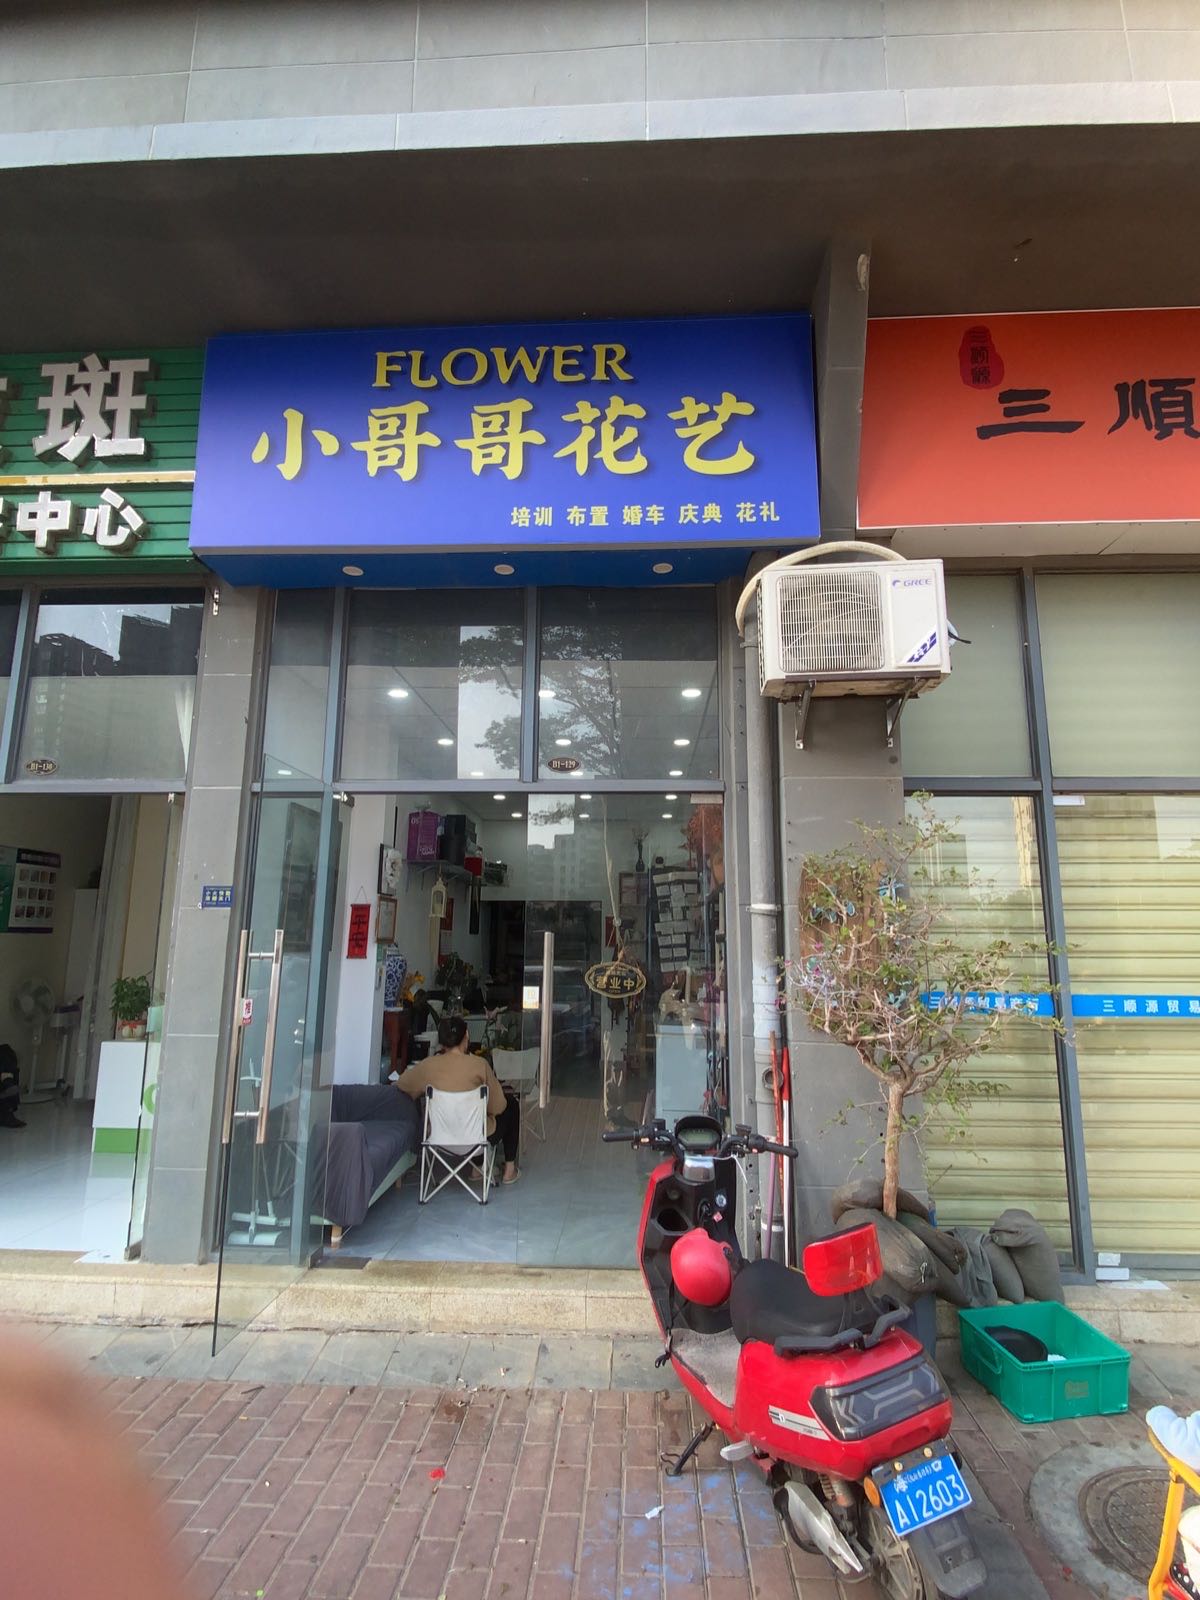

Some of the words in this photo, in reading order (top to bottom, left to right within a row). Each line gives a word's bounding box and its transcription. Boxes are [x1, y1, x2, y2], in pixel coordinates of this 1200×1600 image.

[372, 343, 634, 389] FLOWER
[0, 353, 150, 462] 斑
[976, 377, 1200, 441] 三順
[251, 392, 755, 482] 小哥哥花艺
[0, 488, 144, 547] 中心
[511, 506, 553, 528] 培训
[566, 505, 609, 527] 布置
[622, 504, 665, 526] 婚车
[678, 502, 722, 525] 庆典
[735, 501, 780, 523] 花礼
[1102, 999, 1200, 1014] 三顺源贸易
[894, 1474, 965, 1529] A12603
